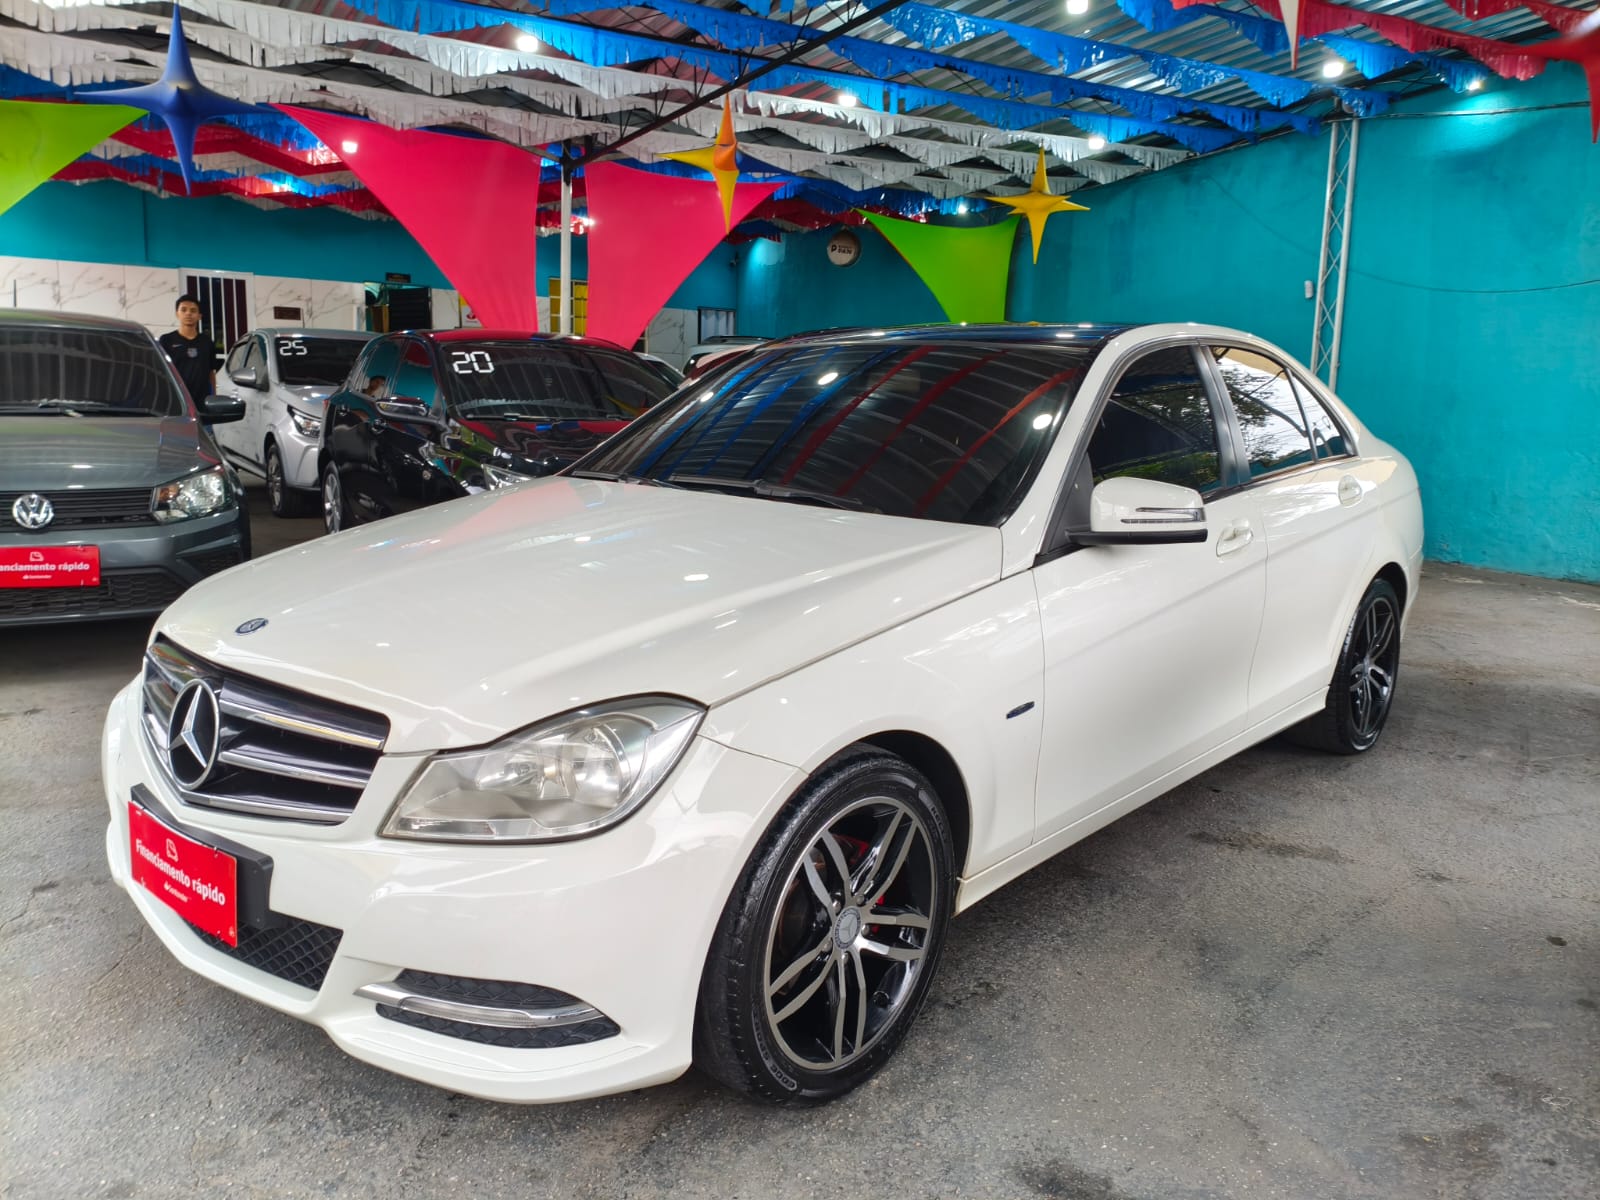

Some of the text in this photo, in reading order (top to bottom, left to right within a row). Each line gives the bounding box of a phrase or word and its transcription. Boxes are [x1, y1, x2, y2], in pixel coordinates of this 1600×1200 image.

[279, 340, 307, 355] 25
[452, 351, 494, 373] 20
[58, 562, 90, 572] rápido
[135, 838, 190, 888] Financiamento
[192, 878, 225, 905] rápido
